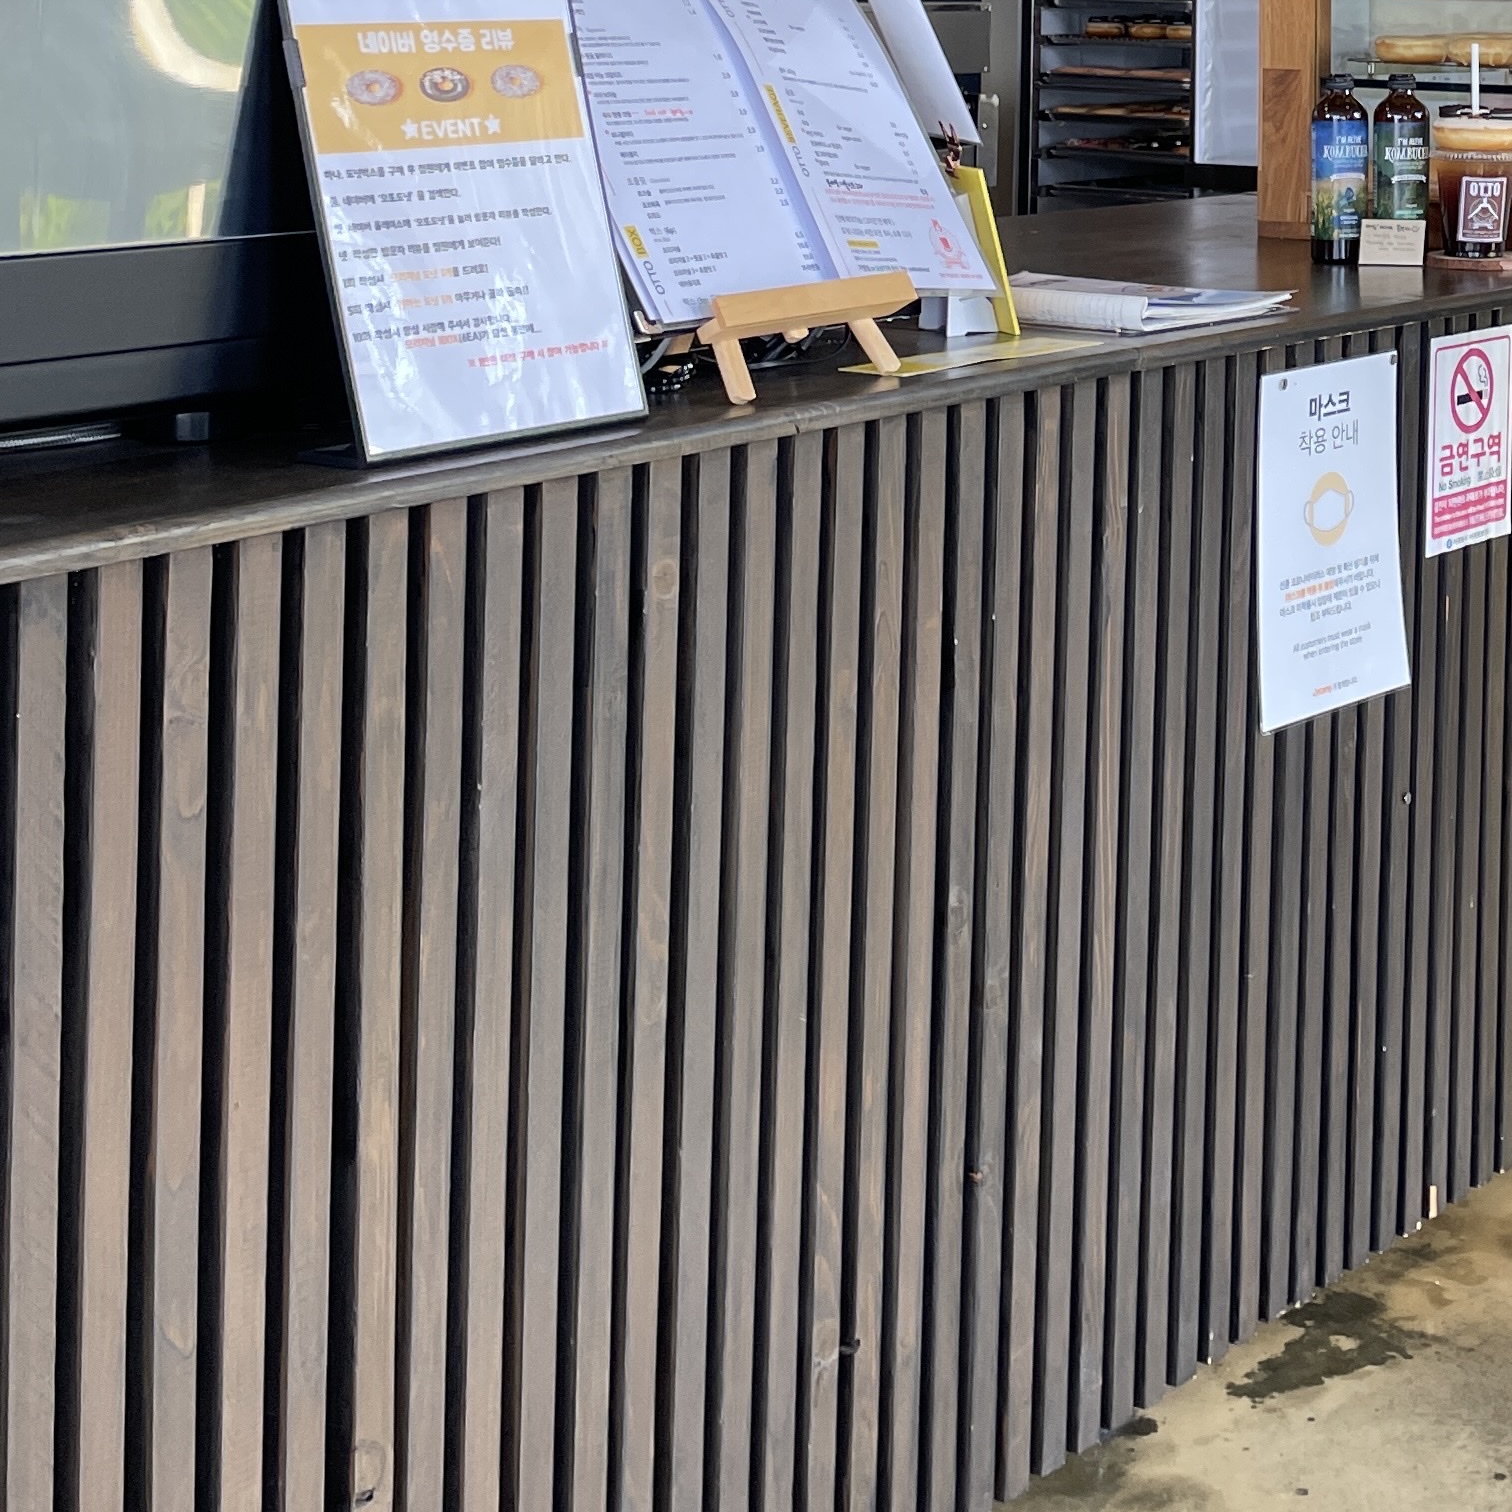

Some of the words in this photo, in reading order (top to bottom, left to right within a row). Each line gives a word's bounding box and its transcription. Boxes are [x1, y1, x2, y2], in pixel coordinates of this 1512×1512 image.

[357, 30, 417, 55] 네이버
[420, 27, 476, 53] 영수증
[479, 28, 515, 52] 리뷰
[421, 117, 482, 140] EVENT
[791, 145, 810, 178] OTTO
[1469, 182, 1501, 197] OTTO
[643, 261, 666, 295] OTTO
[1308, 390, 1351, 422] 마스크
[1298, 427, 1327, 456] 착용
[1331, 418, 1358, 450] 안내
[1439, 431, 1502, 477] 금연구역
[1438, 481, 1448, 492] No
[1448, 476, 1472, 490] Smoking
